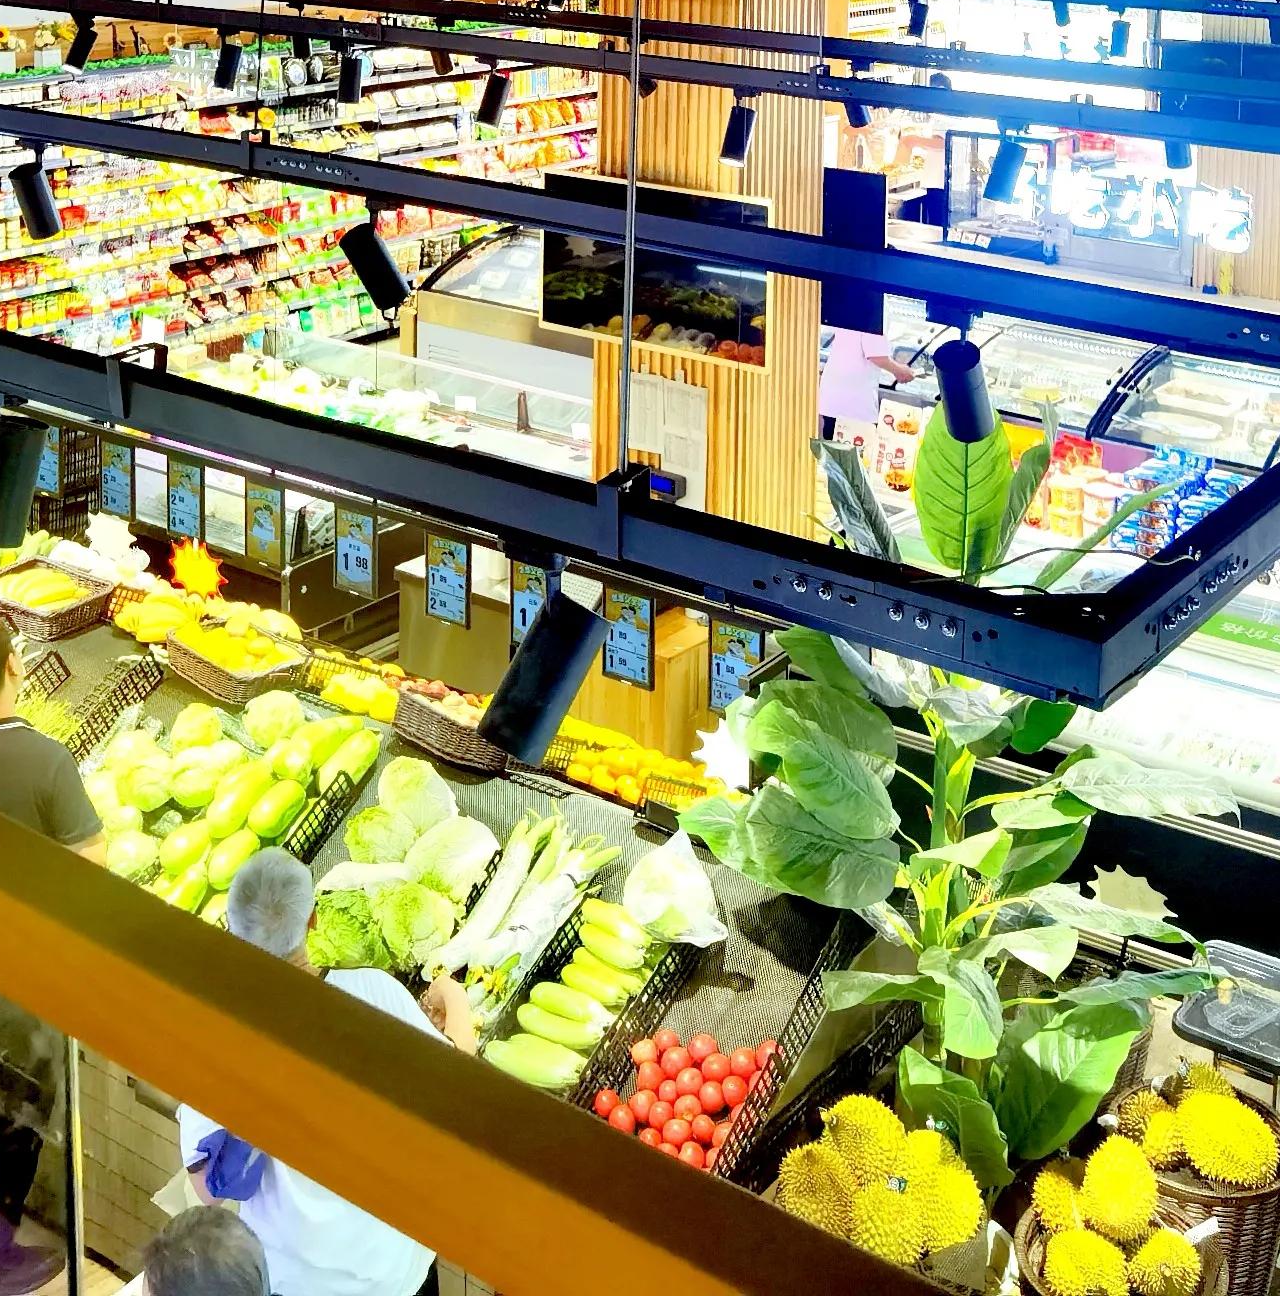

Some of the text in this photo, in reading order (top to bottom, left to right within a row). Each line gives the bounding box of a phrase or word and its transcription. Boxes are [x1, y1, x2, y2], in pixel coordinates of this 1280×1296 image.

[343, 552, 368, 571] 1 98
[430, 597, 437, 611] 2
[520, 607, 527, 627] 1
